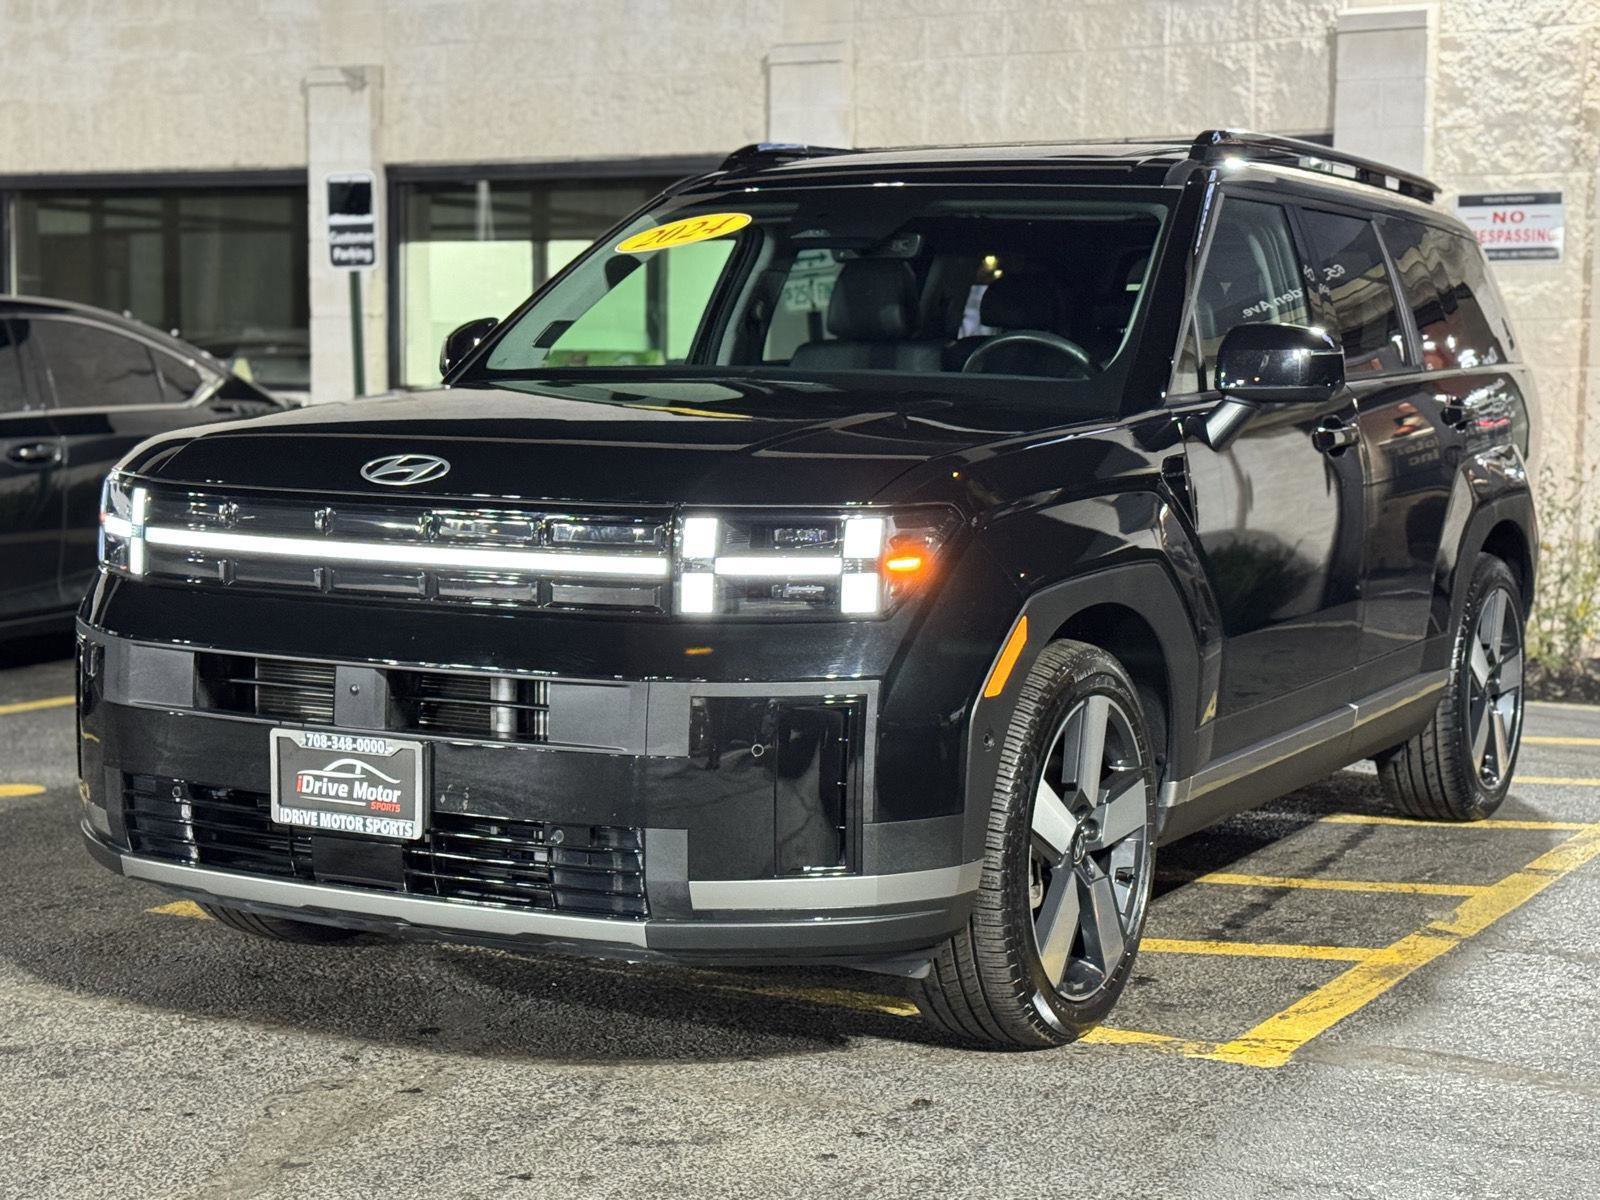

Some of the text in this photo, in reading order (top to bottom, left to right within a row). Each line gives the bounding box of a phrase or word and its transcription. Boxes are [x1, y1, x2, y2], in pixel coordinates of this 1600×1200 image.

[1492, 211, 1526, 224] NO
[632, 216, 736, 249] 2024
[1474, 227, 1557, 244] ESPASSING
[332, 247, 373, 263] Parking
[306, 733, 386, 754] 708-348-0000
[296, 775, 402, 803] iDrive Motor
[370, 800, 401, 813] SPORTS
[319, 812, 364, 832] MOTOR
[365, 817, 414, 837] SPORTS
